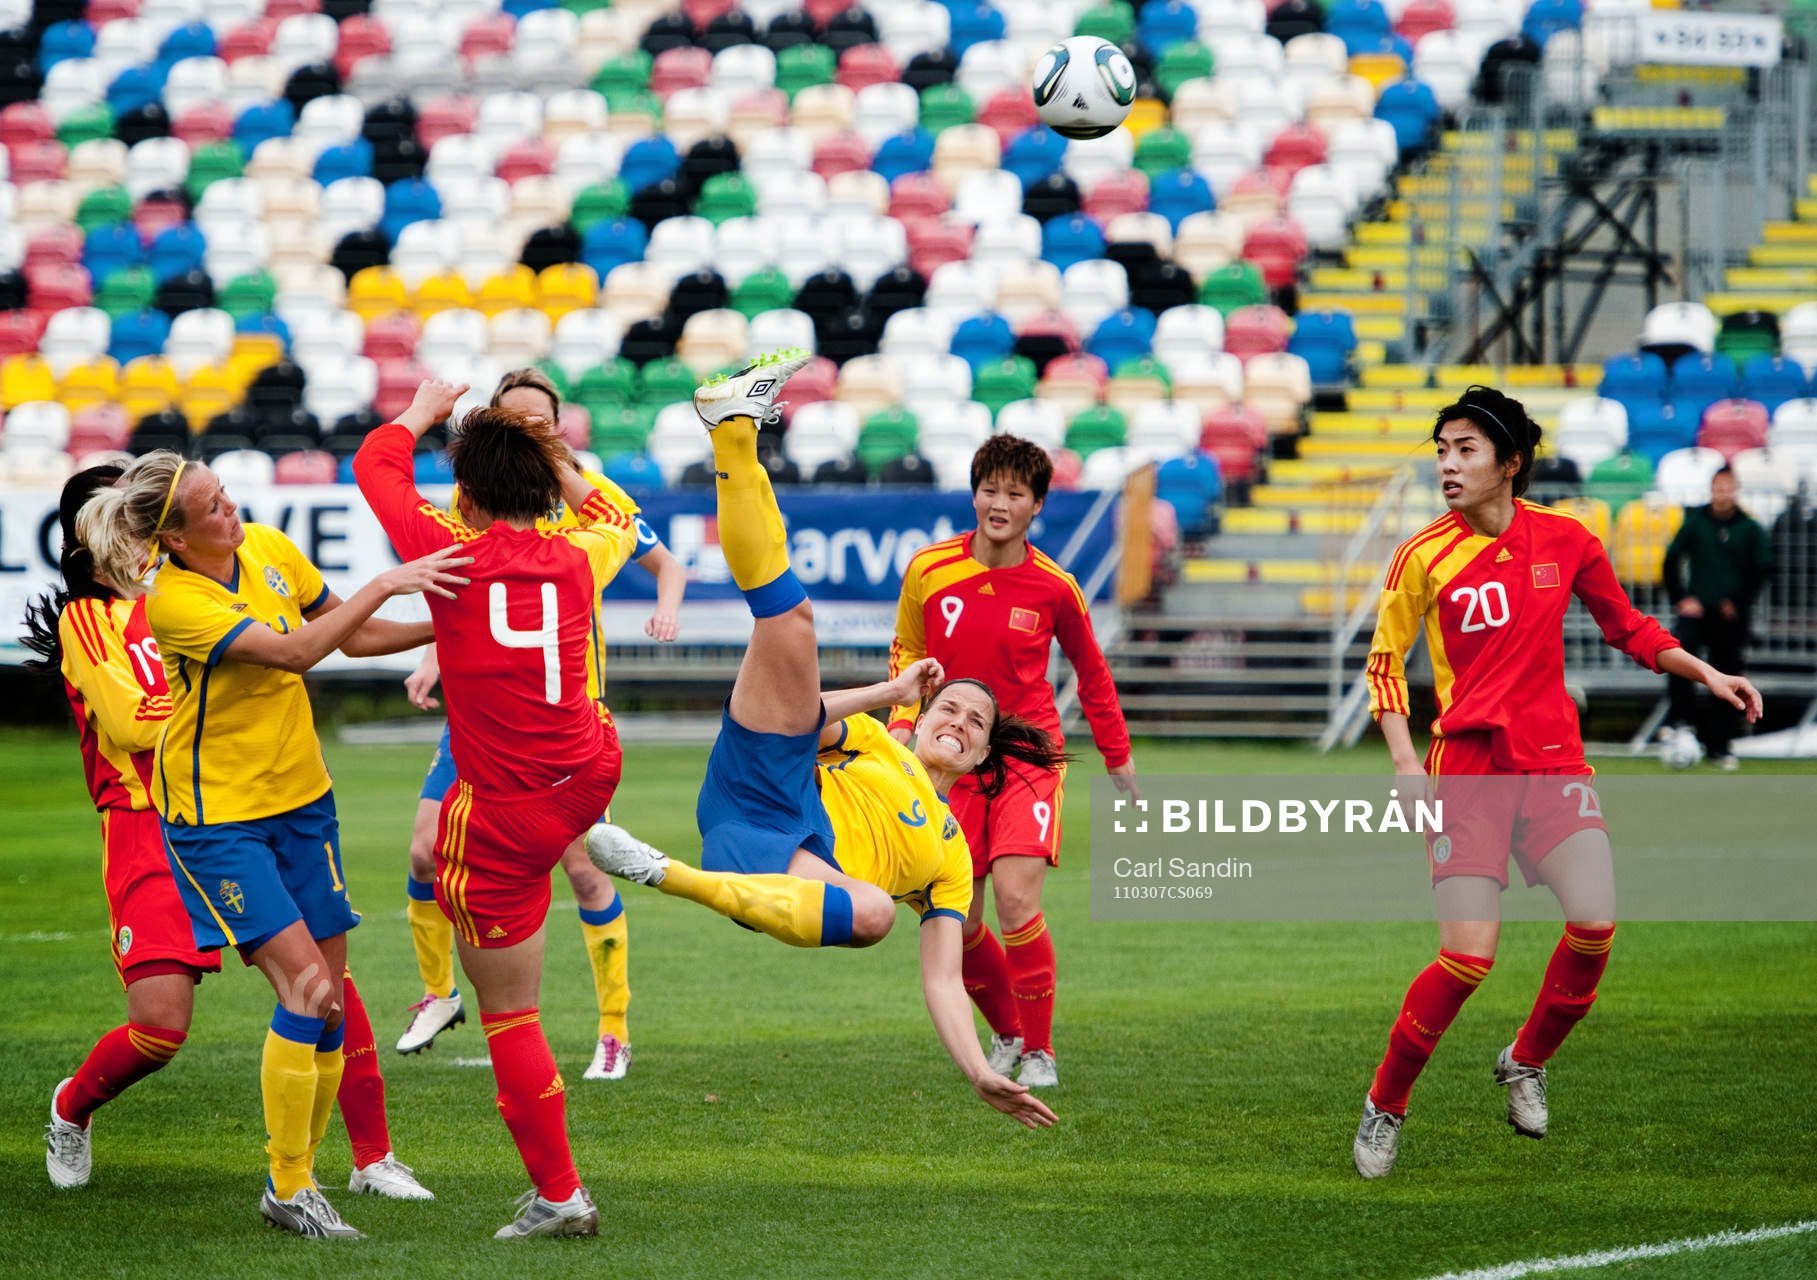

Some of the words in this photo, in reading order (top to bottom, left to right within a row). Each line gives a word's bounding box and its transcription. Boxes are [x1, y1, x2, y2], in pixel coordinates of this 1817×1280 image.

[940, 595, 964, 639] 9
[1450, 581, 1511, 634] 20
[128, 636, 168, 686] 19
[488, 581, 561, 704] 4
[1032, 800, 1051, 843] 9
